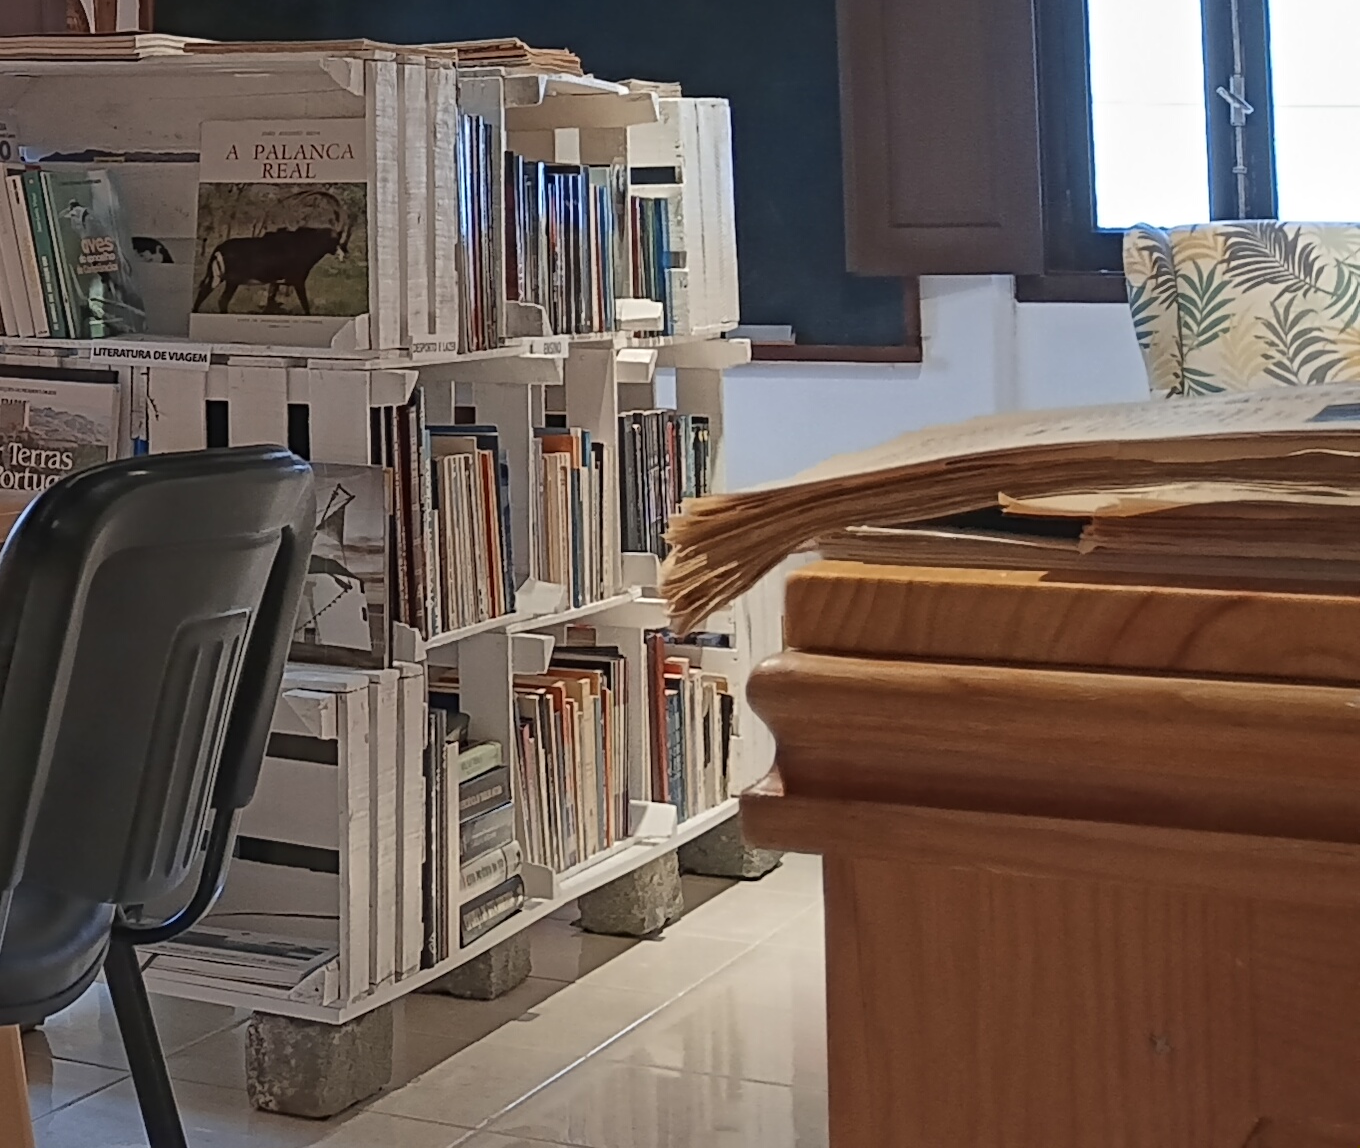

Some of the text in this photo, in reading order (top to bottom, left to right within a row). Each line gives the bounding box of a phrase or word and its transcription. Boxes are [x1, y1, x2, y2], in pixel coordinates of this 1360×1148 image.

[225, 143, 355, 160] A PALANCA
[262, 162, 317, 179] REAL
[93, 347, 208, 363] LITERATURA DE VIAGEM
[8, 440, 73, 470] Terras
